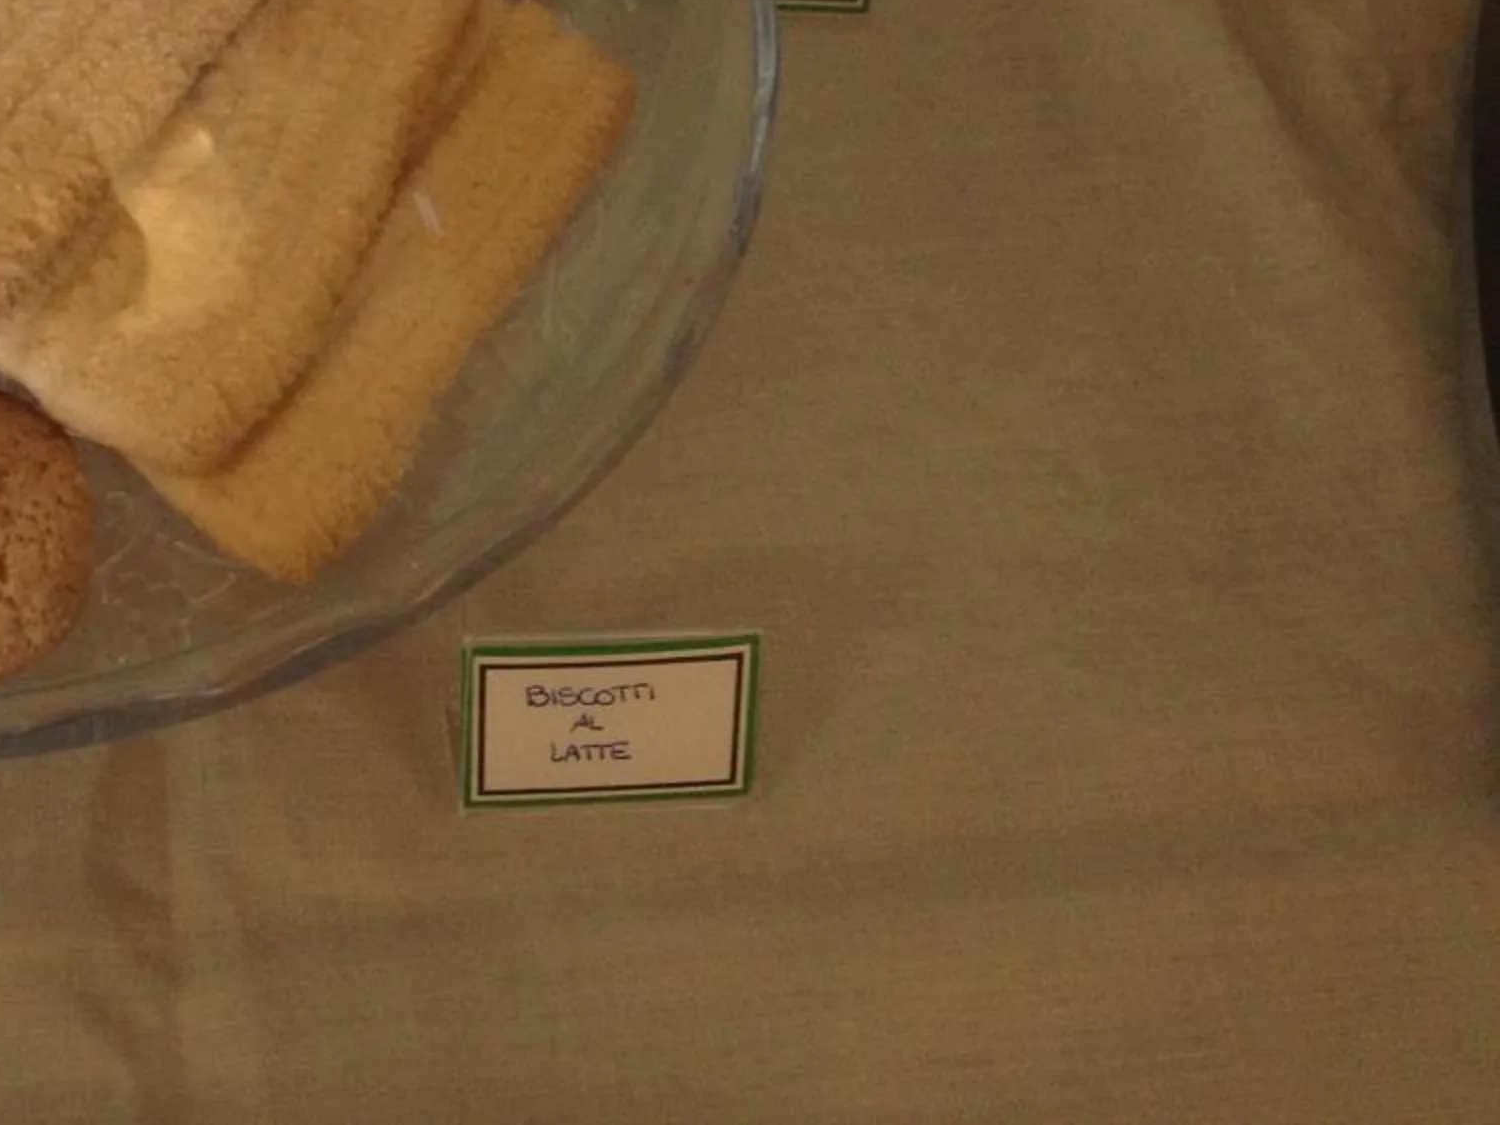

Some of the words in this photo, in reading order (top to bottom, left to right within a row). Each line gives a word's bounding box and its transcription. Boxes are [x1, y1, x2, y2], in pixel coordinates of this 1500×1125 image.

[525, 683, 656, 707] BISCOTTI
[568, 713, 605, 733] AL
[550, 741, 633, 764] LATTE
